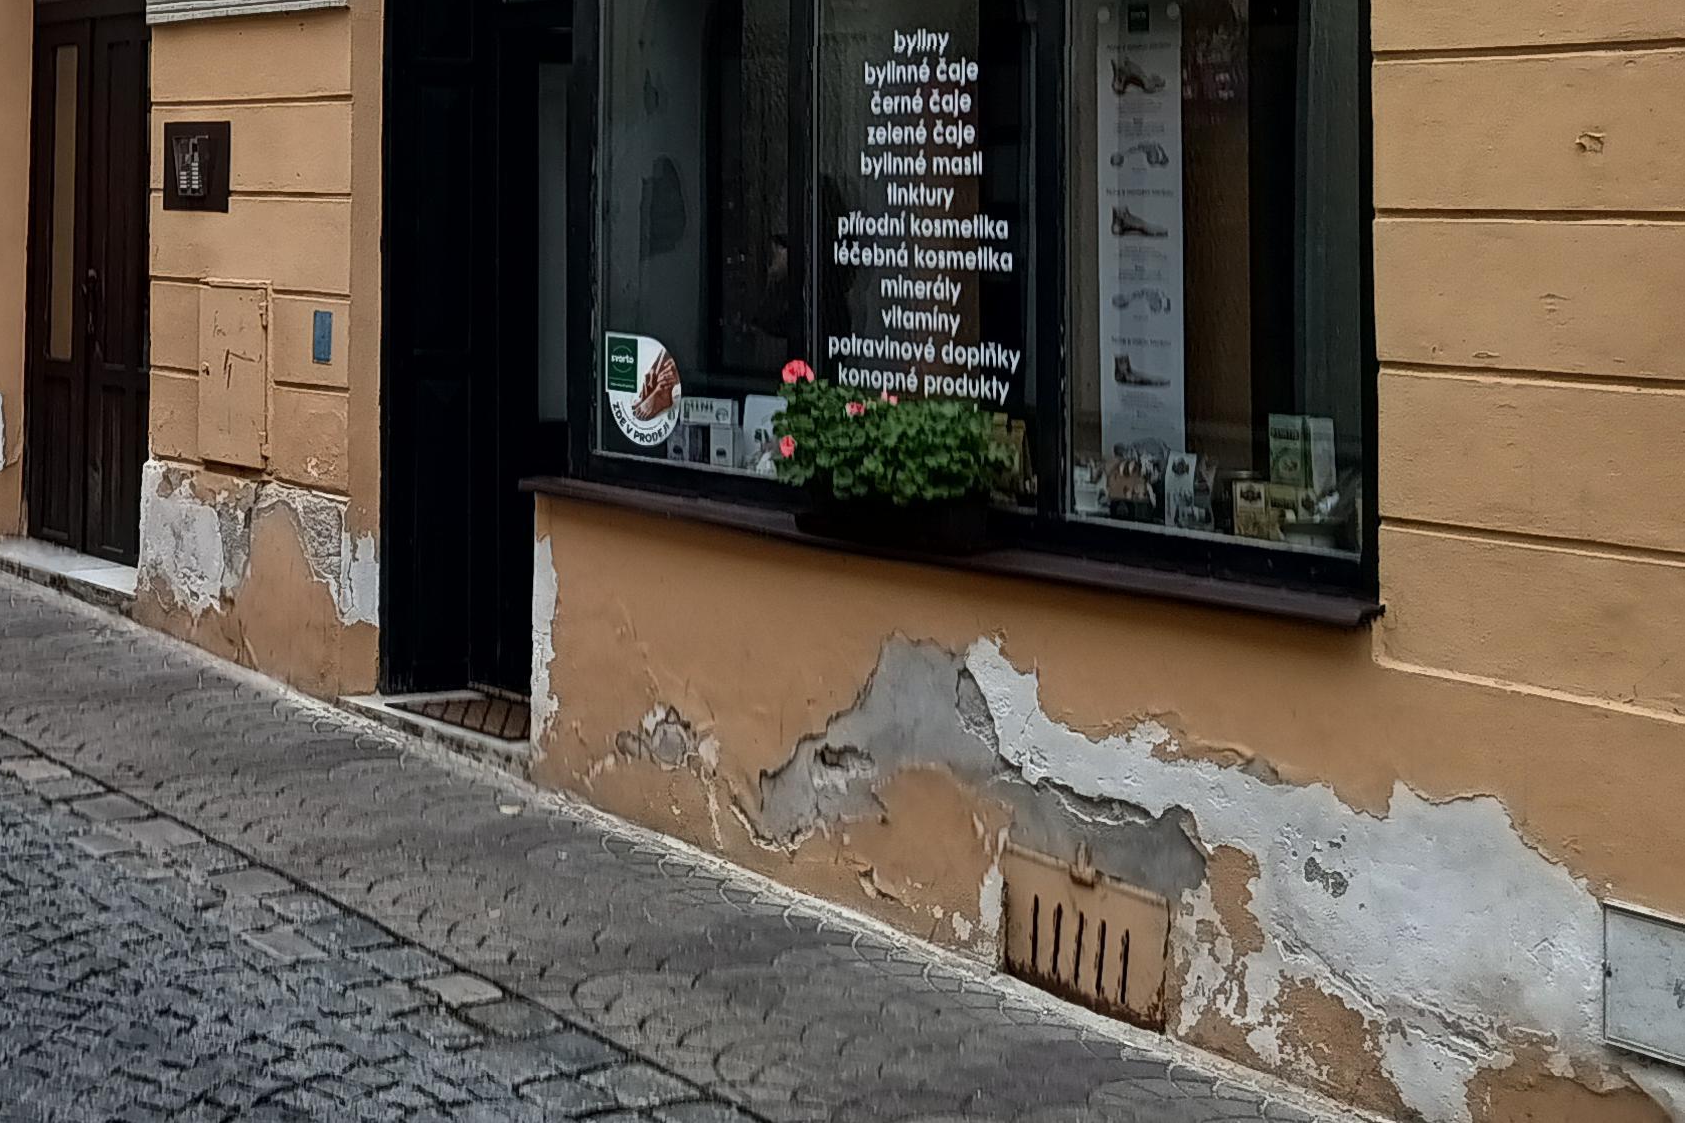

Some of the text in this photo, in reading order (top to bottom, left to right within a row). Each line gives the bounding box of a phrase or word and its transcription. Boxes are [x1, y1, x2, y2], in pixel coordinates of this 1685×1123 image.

[893, 28, 950, 58] byliny
[864, 56, 979, 89] bylinné čaje
[870, 87, 972, 118] černé čaje
[867, 118, 976, 149] zelené čaje
[860, 148, 983, 180] bylinné masti
[886, 182, 955, 212] tinktury
[837, 209, 1009, 241] přírodní kosmetika
[833, 241, 1013, 273] léčebná kosmetika
[880, 273, 963, 307] minerály
[881, 304, 962, 337] vitamíny
[828, 333, 1021, 375] potravinové doplňky
[837, 363, 1011, 407] konopné produkty
[612, 401, 627, 427] ZDE
